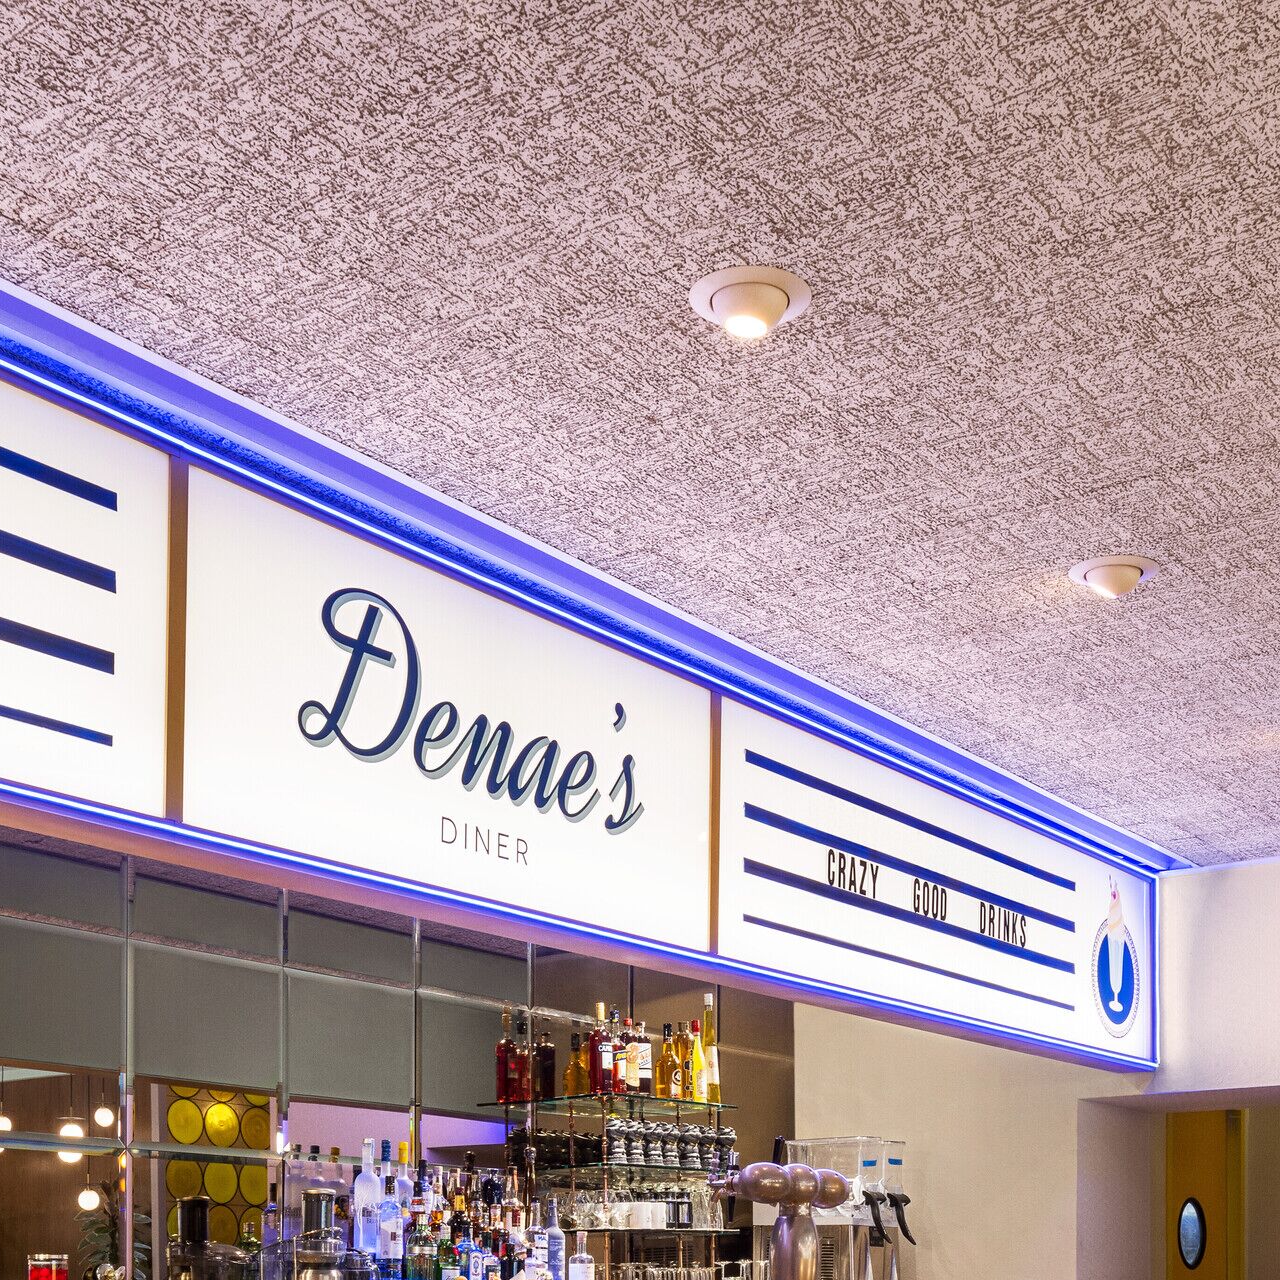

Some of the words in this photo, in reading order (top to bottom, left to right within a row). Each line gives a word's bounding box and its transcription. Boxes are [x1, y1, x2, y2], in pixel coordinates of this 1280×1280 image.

[297, 587, 645, 835] Denae's
[440, 815, 529, 866] DINER
[826, 848, 880, 899] CRAZY
[912, 877, 948, 922] GOOD
[979, 901, 1027, 949] DRINKS
